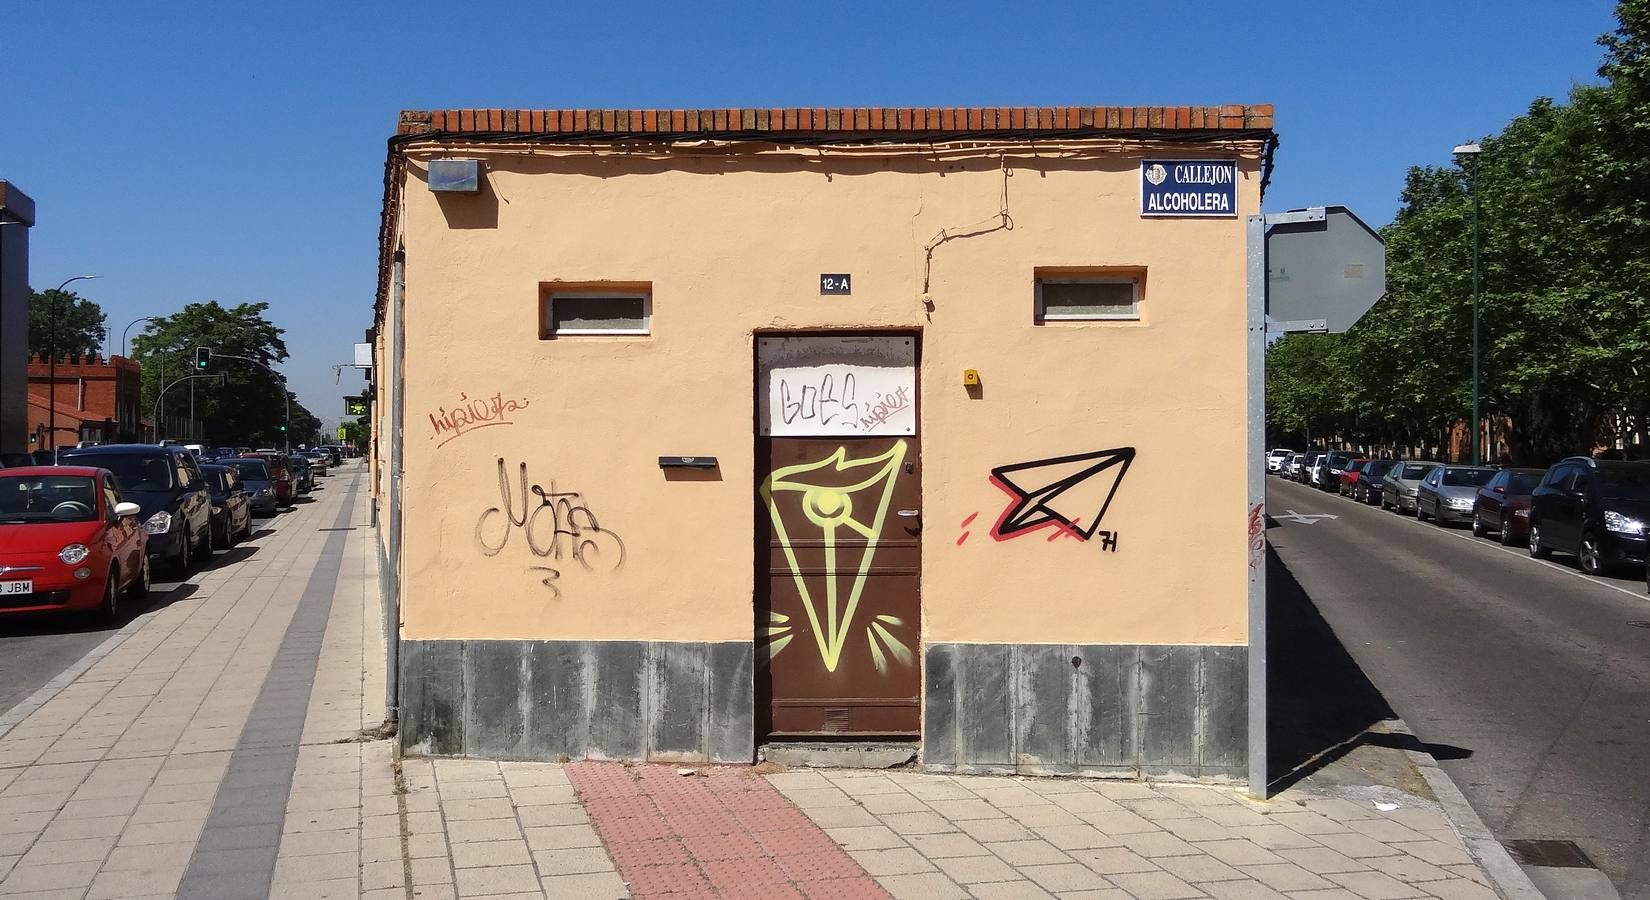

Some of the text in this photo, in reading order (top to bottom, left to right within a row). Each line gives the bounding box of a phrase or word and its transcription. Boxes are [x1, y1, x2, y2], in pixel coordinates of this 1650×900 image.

[1174, 165, 1232, 185] CALLEJON
[1148, 192, 1229, 211] ALCOHOLERA
[7, 582, 30, 593] JBM
